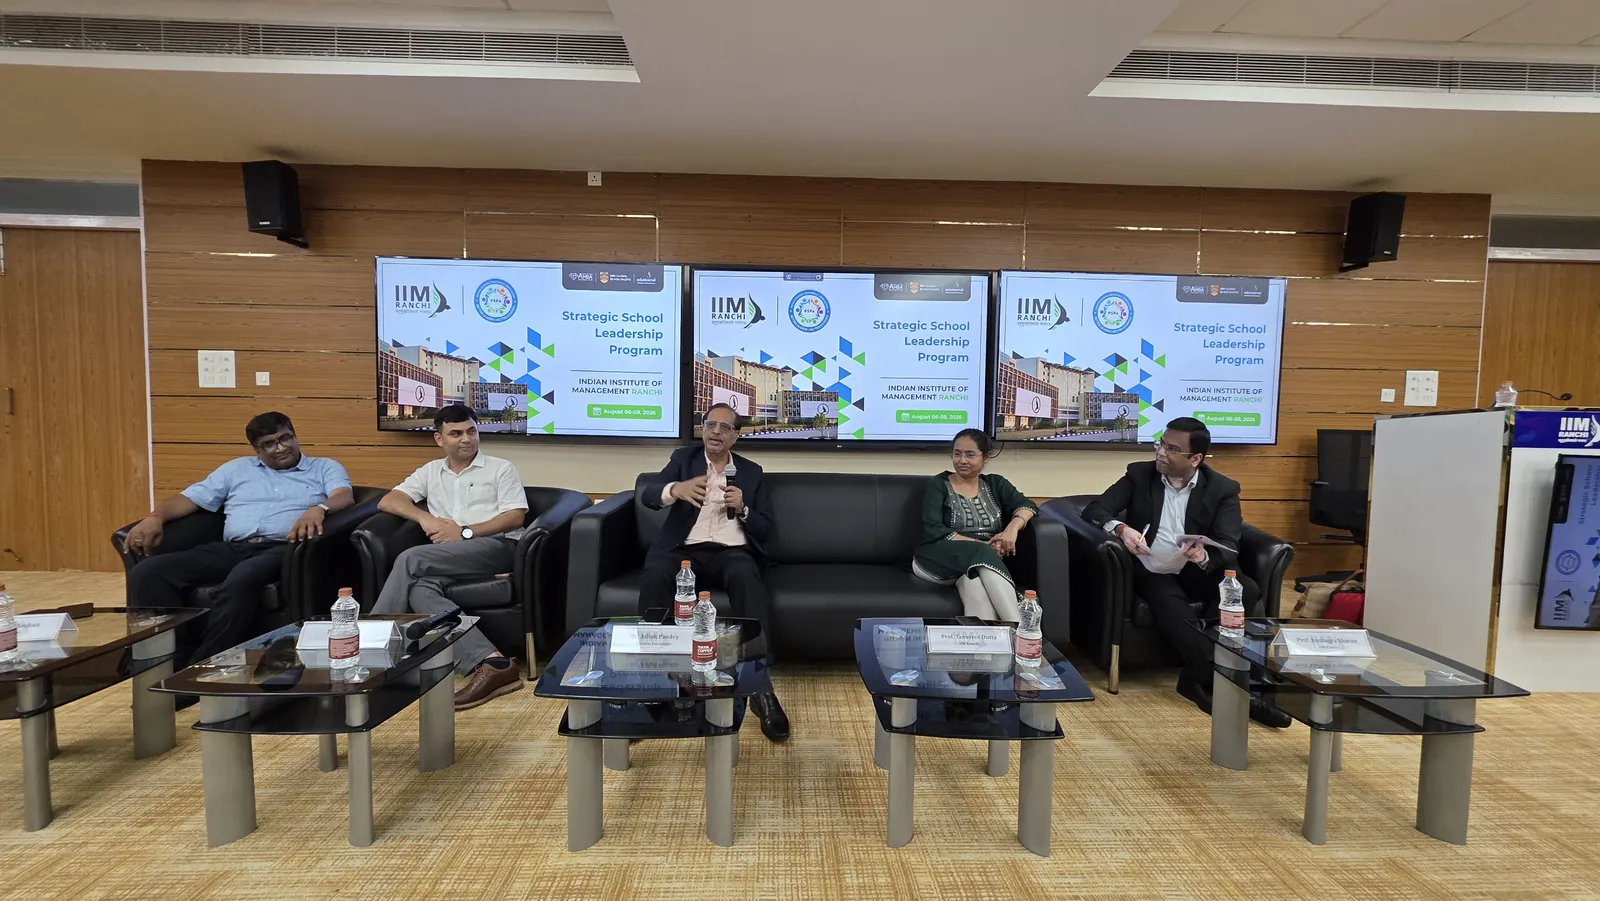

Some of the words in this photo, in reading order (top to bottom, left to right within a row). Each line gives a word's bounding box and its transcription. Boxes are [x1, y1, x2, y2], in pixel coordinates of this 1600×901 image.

[395, 285, 430, 302] IIM
[711, 297, 746, 313] IIM
[1017, 298, 1052, 315] IIM
[562, 311, 619, 324] Strategic
[621, 312, 664, 323] School
[873, 320, 928, 332] Strategic
[930, 321, 970, 331] School
[1174, 322, 1225, 335] Strategic
[1228, 323, 1267, 334] School
[595, 328, 664, 341] Leadership
[904, 336, 970, 348] Leadership
[1203, 339, 1266, 351] Leadership
[609, 345, 663, 357] Program
[918, 352, 969, 364] Program
[1215, 355, 1264, 367] Program
[609, 379, 650, 387] INSTITUTE
[572, 387, 630, 395] MANAGEMENT
[1560, 417, 1590, 431] IIM
[1578, 491, 1590, 524] Strategic
[658, 633, 680, 642] Pandey
